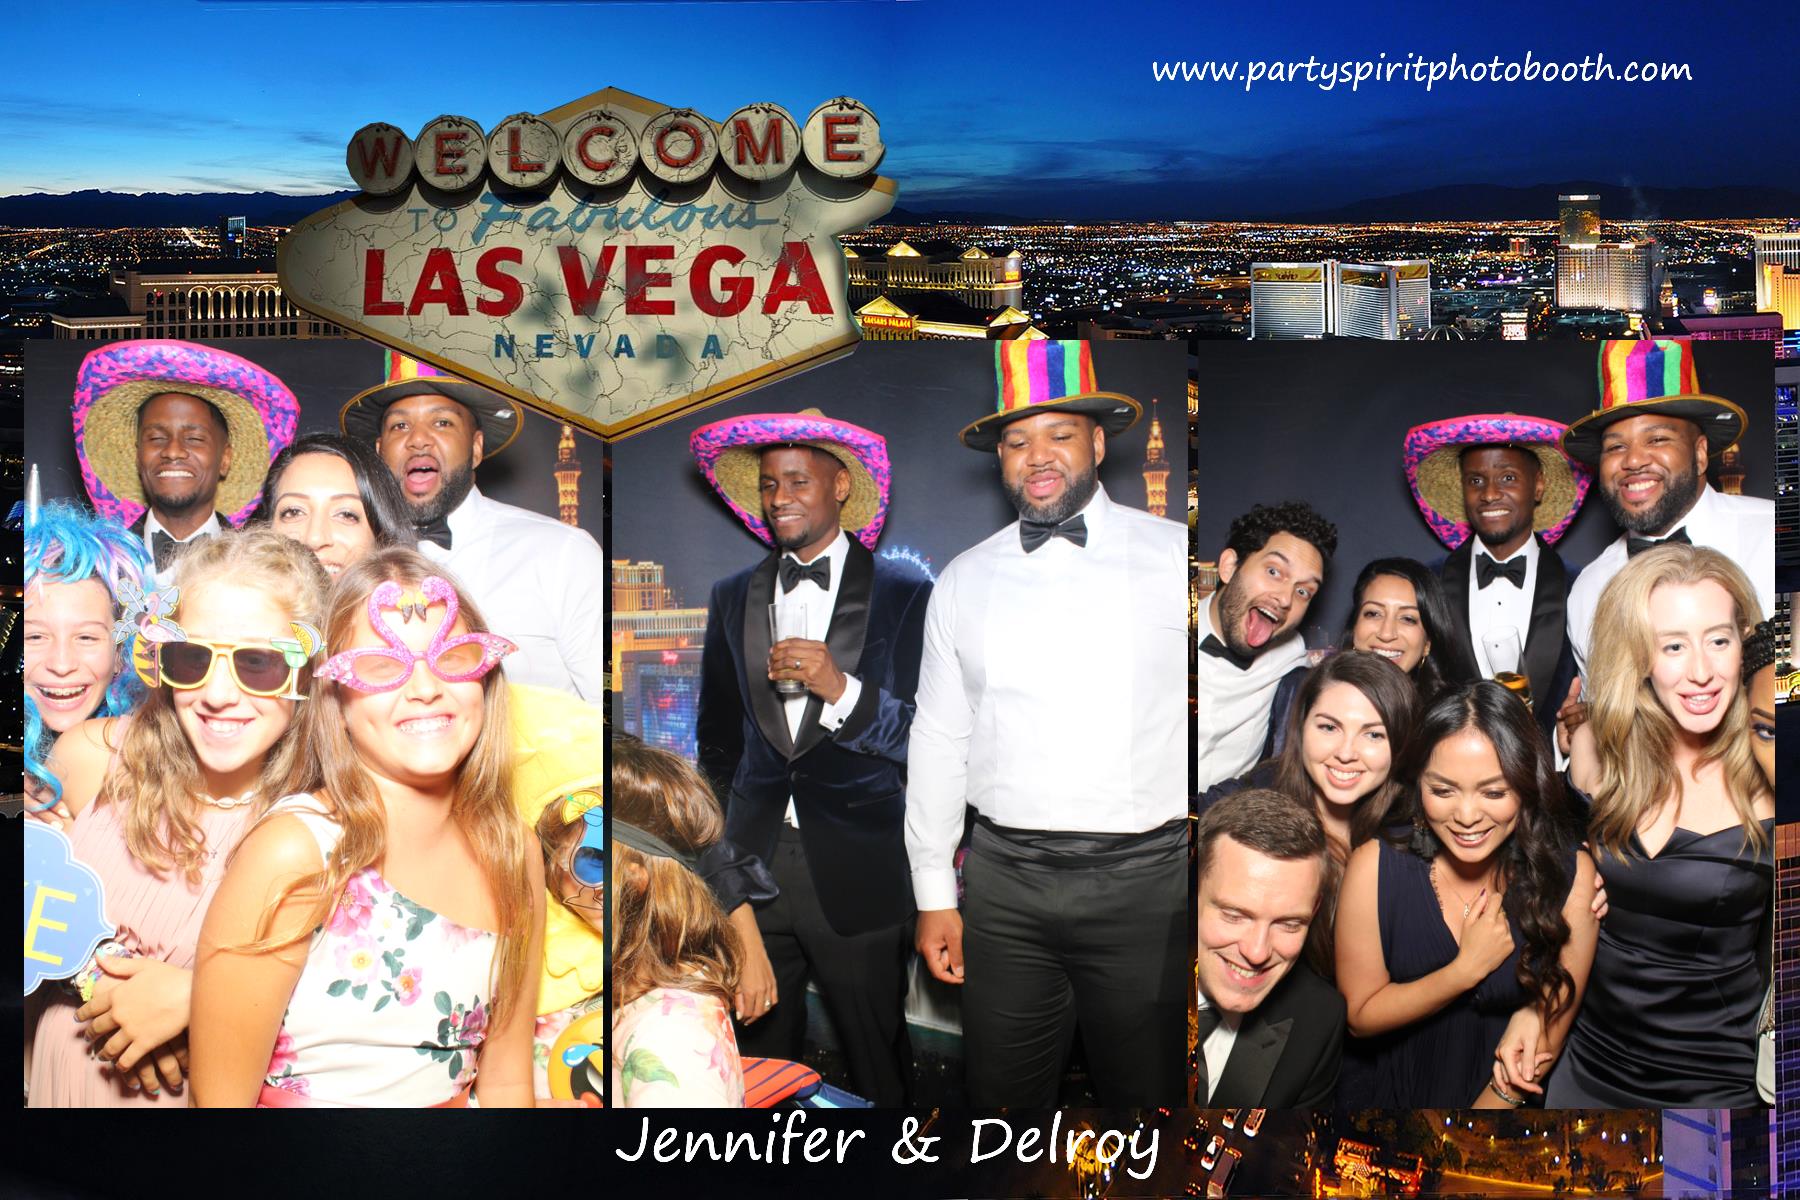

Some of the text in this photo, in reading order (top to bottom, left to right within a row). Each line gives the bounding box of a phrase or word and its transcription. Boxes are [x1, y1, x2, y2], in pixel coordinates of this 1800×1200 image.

[359, 112, 867, 178] WELCOME
[406, 188, 782, 246] TO Fabulous
[363, 241, 835, 317] LAS VEGA
[494, 333, 724, 359] NEVADA
[888, 318, 911, 328] PALACE
[24, 884, 77, 966] E
